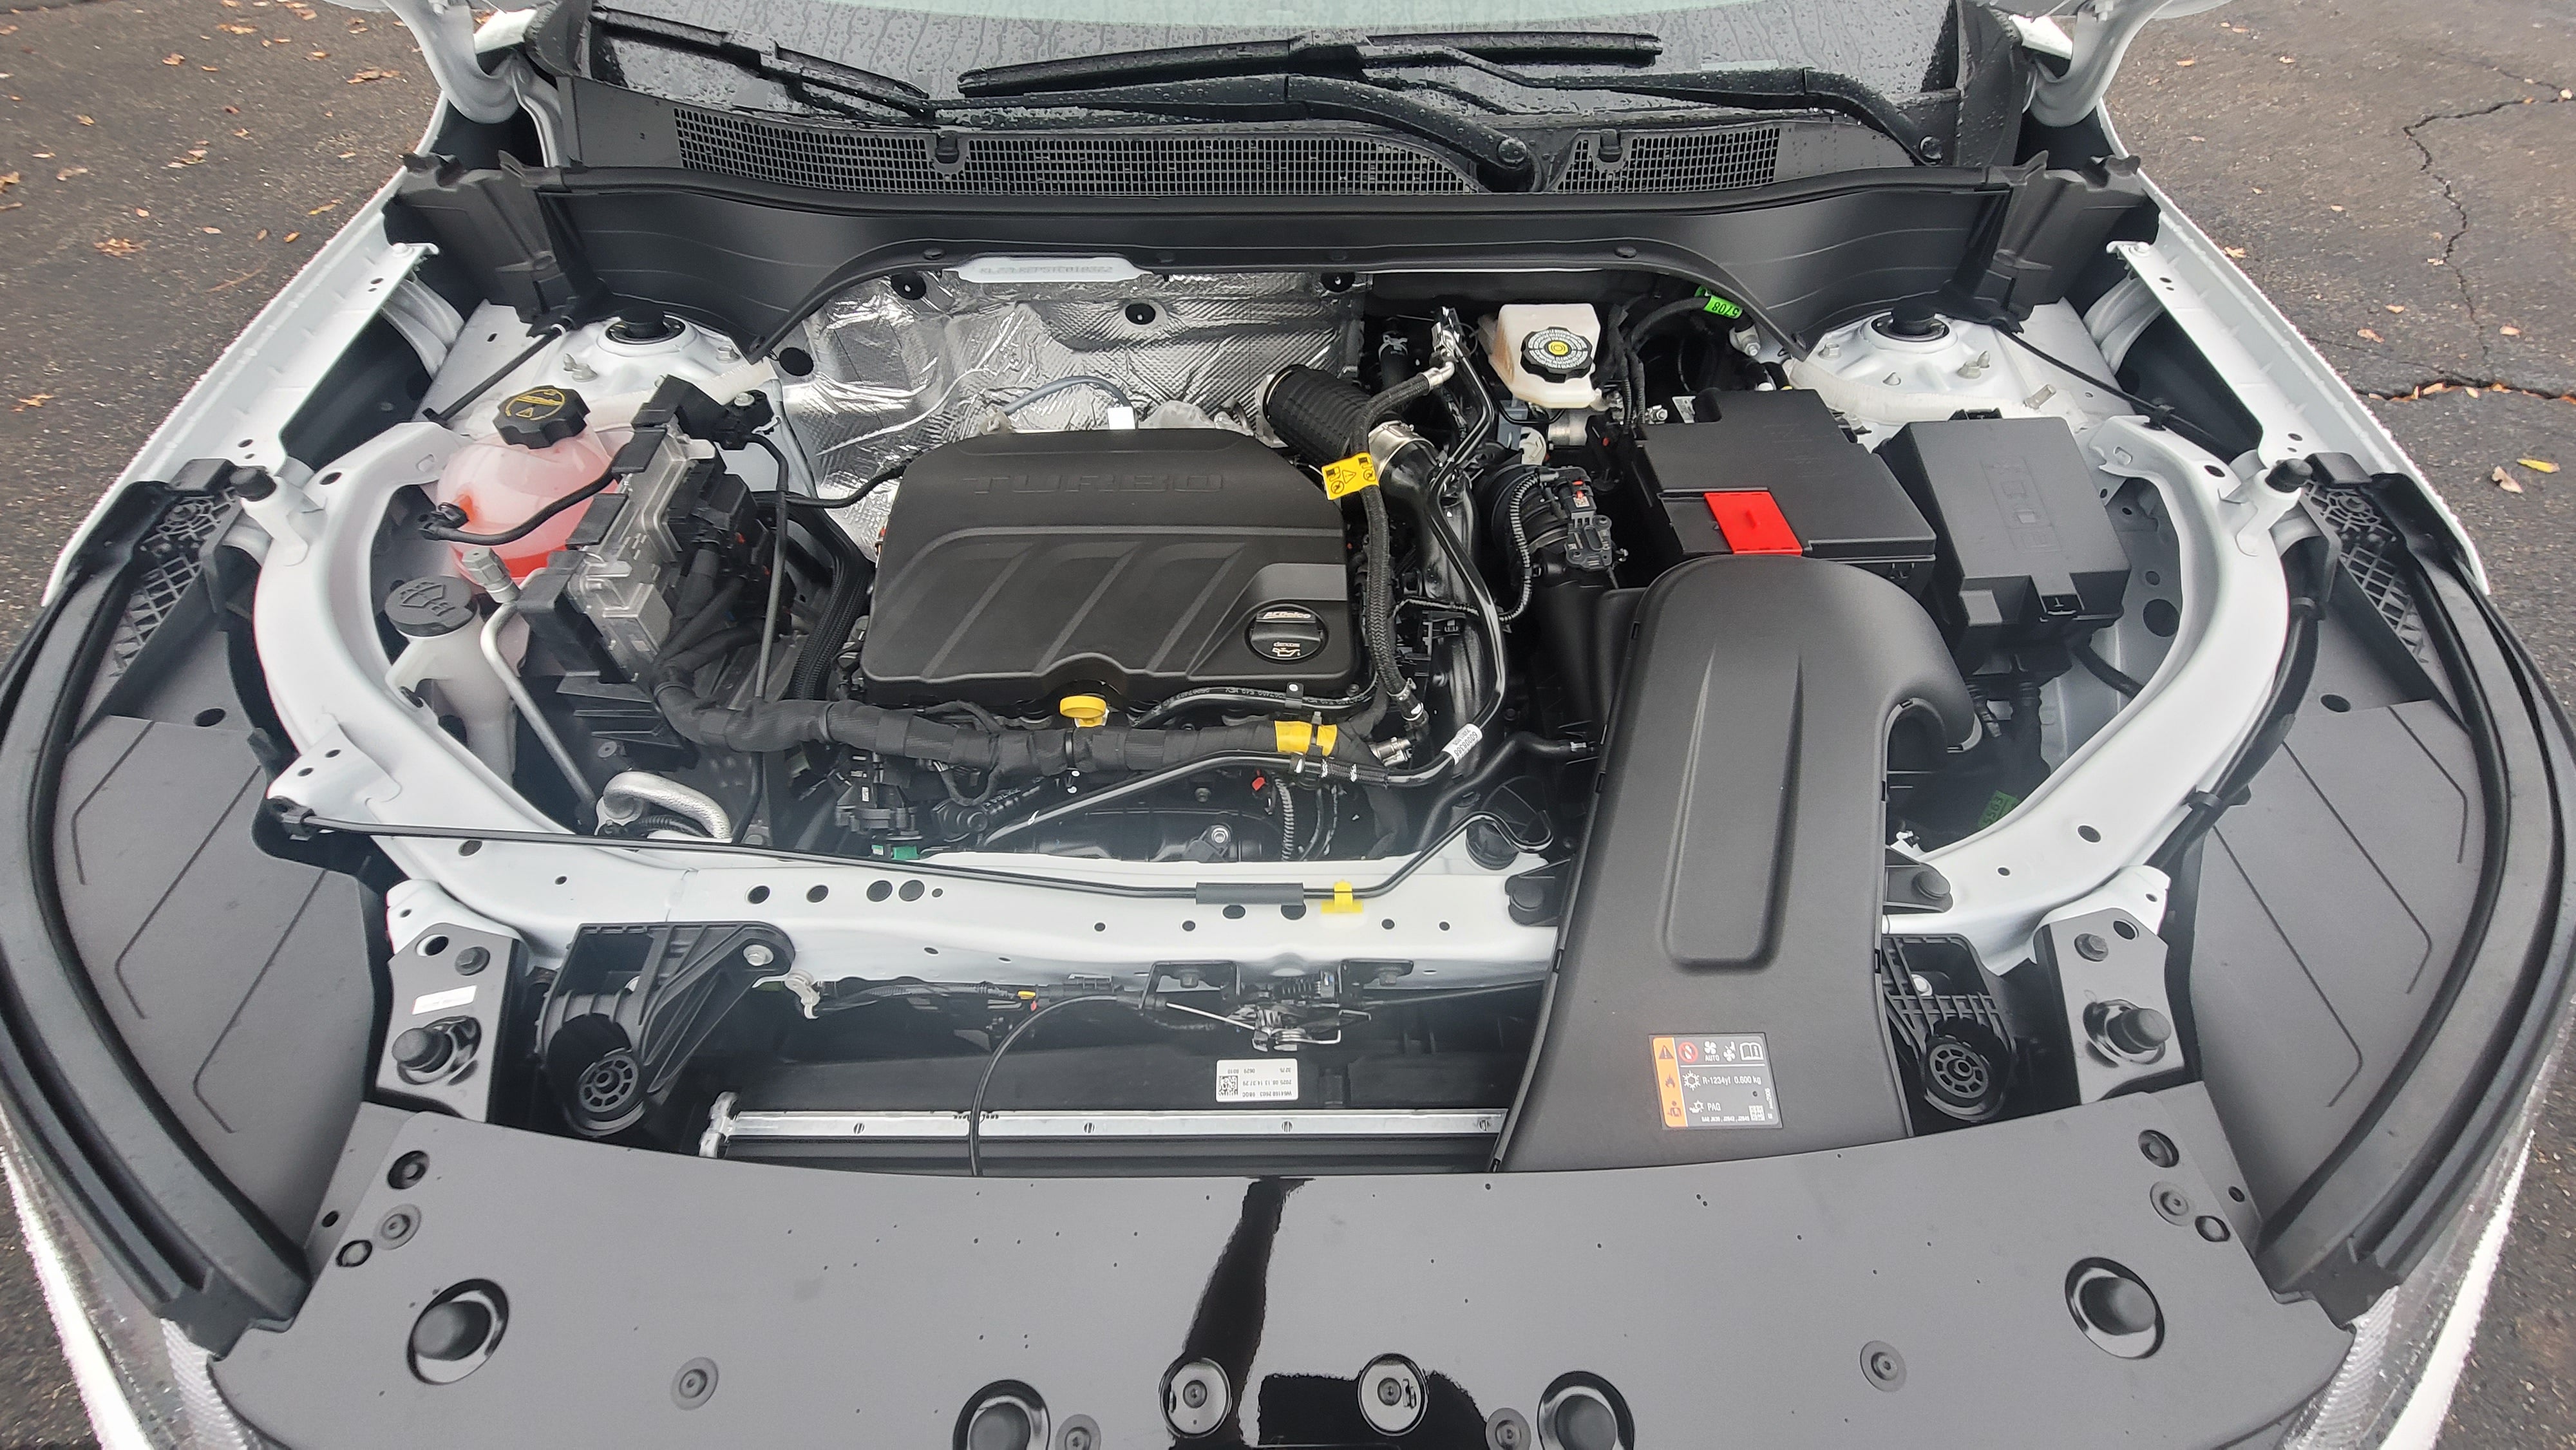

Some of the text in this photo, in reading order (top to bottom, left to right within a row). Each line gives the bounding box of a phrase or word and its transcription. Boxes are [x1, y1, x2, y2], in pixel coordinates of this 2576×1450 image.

[1712, 302, 1740, 317] 5708
[963, 473, 1224, 494] TURBO
[1752, 1075, 1761, 1086] kg
[1707, 1102, 1721, 1111] PAG
